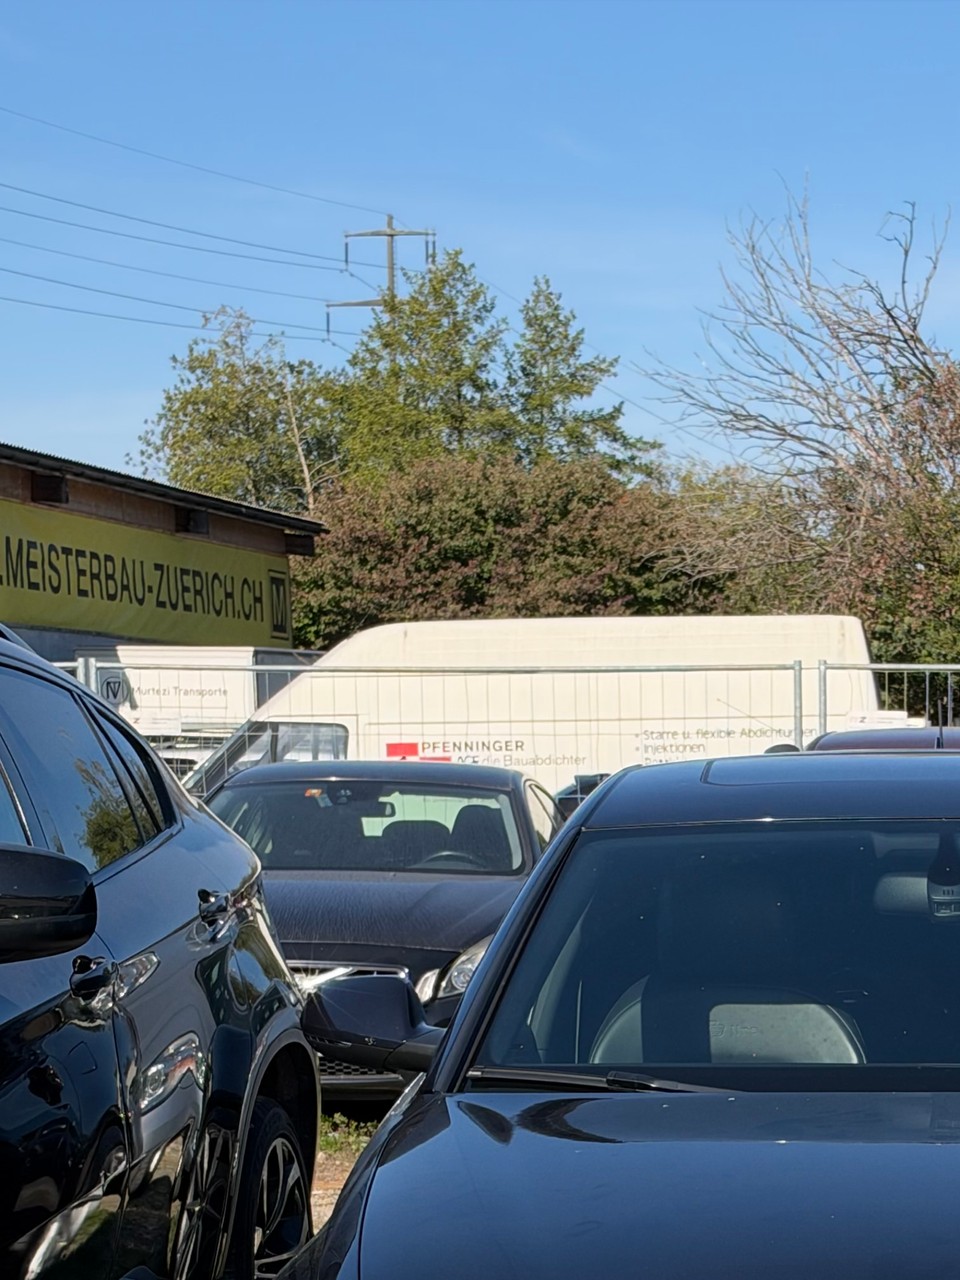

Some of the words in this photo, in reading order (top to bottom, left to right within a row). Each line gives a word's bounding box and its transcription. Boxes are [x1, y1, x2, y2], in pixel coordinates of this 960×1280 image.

[131, 686, 171, 696] Murtezi
[173, 686, 228, 698] Transporte
[643, 729, 679, 740] Starre
[696, 728, 737, 739] flexible
[421, 740, 525, 753] PFENNINGER
[643, 743, 705, 755] Injektionen
[503, 755, 587, 767] Bauabdichter
